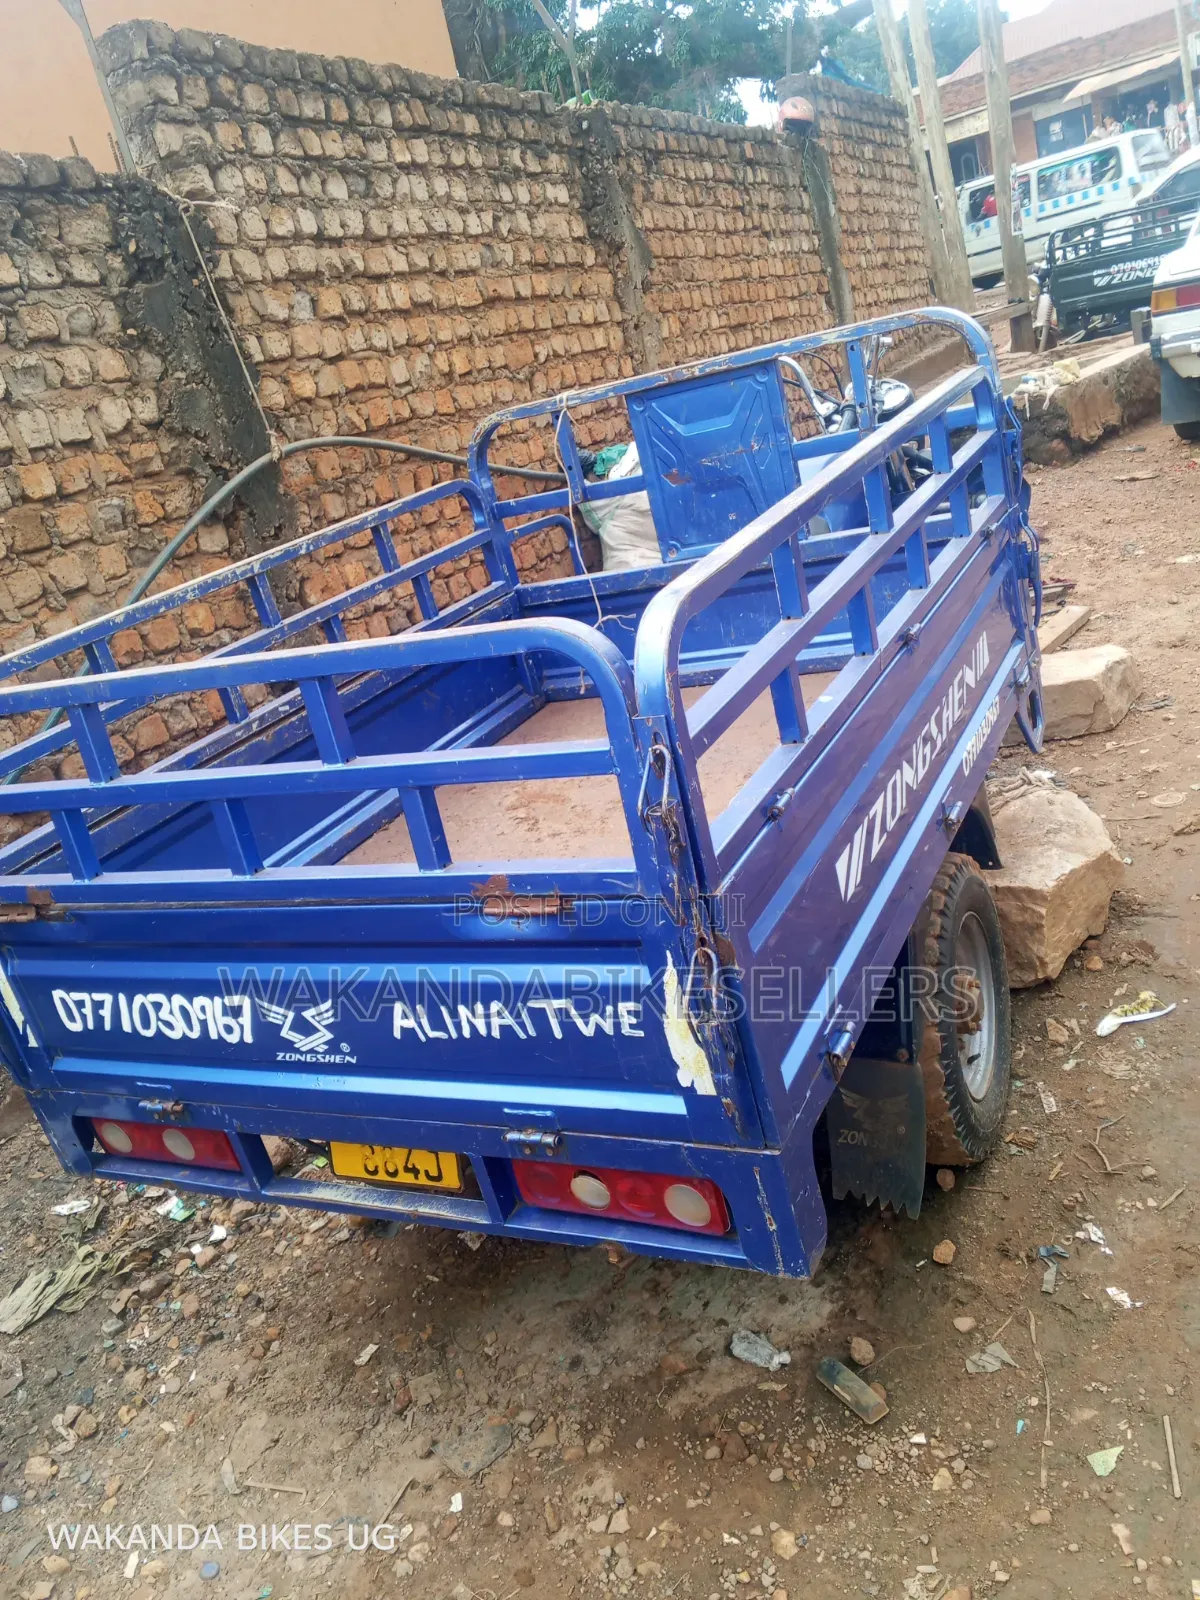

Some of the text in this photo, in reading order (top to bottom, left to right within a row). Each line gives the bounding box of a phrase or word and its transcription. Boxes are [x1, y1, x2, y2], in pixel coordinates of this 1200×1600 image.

[869, 645, 976, 864] ZONGSHEN
[52, 989, 254, 1044] 0771030967
[393, 998, 645, 1042] ALINAITWE
[276, 1052, 357, 1064] ZONGSHEN
